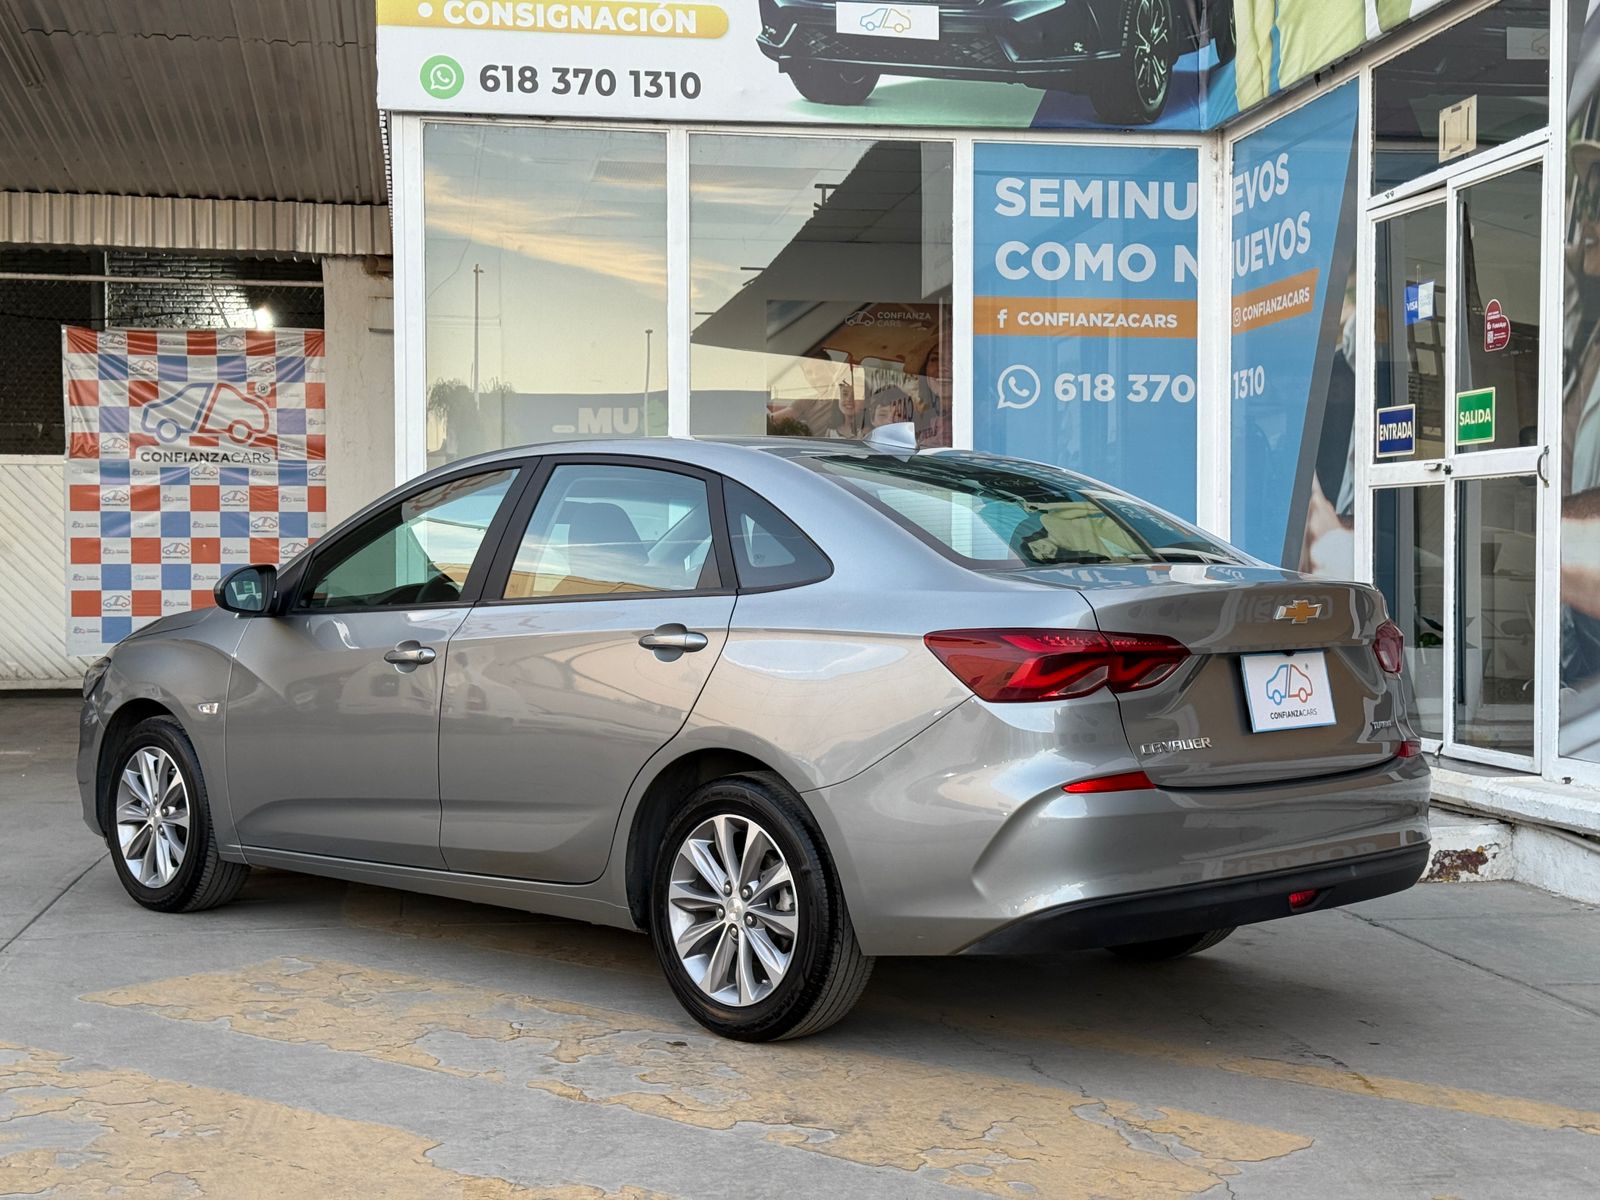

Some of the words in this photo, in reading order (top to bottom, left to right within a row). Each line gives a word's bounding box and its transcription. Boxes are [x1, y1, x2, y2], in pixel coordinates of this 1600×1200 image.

[443, 0, 697, 34] CONSIGNACIÓN
[479, 64, 539, 94] 618
[551, 66, 617, 97] 370
[629, 70, 702, 99] 1310
[994, 177, 1197, 220] SEMINU
[995, 240, 1157, 282] COMO
[877, 311, 932, 321] CONFIANZA
[1242, 286, 1310, 322] CONFIANZACARS
[1017, 311, 1178, 329] CONFIANZACARS
[1053, 373, 1116, 402] 618
[1126, 374, 1195, 403] 370
[1233, 365, 1265, 400] 1310
[1459, 407, 1492, 426] SALIDA
[1379, 421, 1413, 441] ENTRADA
[140, 451, 271, 464] CONFIANZACARS
[1269, 707, 1318, 720] CONFIANZACARS
[1140, 736, 1213, 755] CAVALIER
